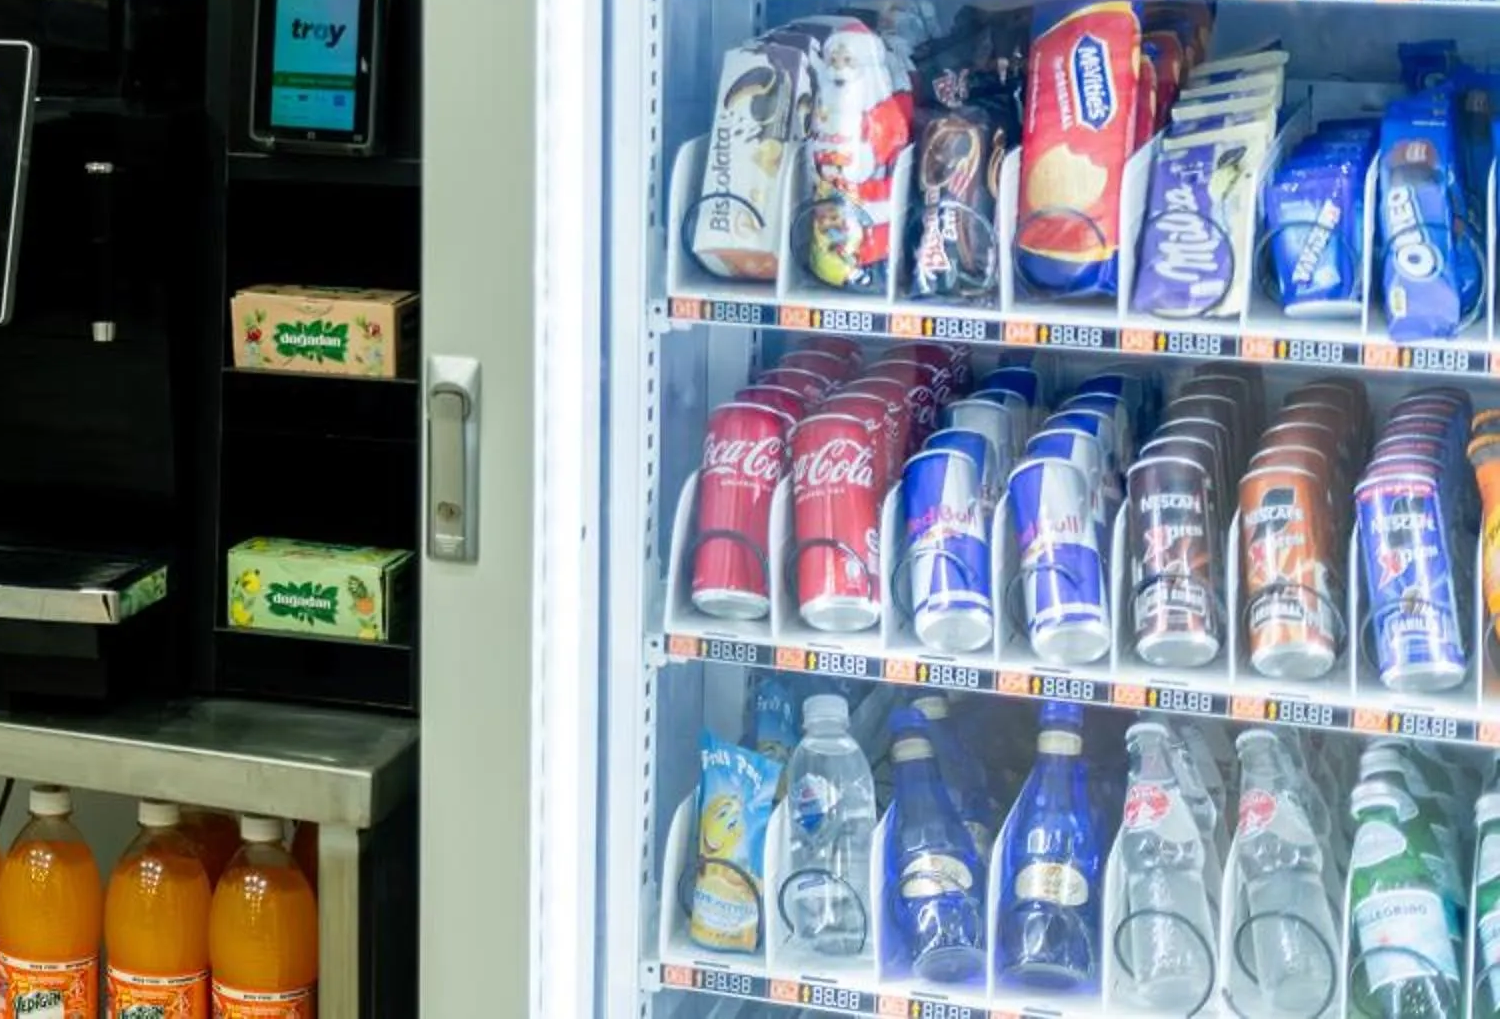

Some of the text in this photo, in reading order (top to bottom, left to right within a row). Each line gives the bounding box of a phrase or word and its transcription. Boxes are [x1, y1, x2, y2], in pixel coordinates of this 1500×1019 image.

[292, 18, 346, 49] troy
[1155, 184, 1222, 281] Milka
[1388, 186, 1438, 279] OREO
